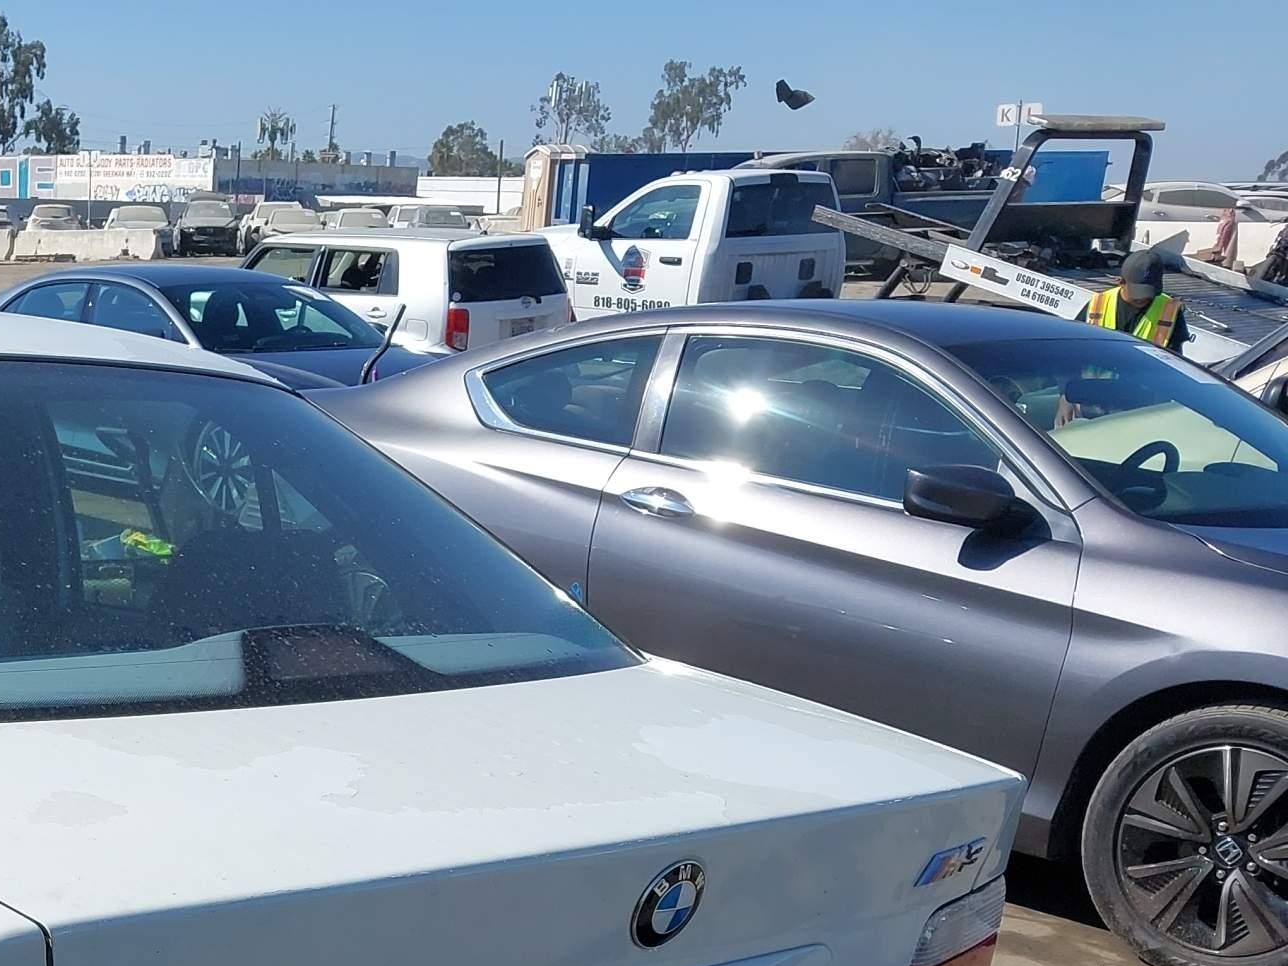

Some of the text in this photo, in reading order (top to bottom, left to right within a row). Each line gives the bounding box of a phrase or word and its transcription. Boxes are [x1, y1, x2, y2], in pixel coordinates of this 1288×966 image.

[1000, 108, 1012, 123] K
[1015, 272, 1075, 300] USDOT 3955492
[1020, 287, 1031, 298] CA
[652, 864, 705, 898] BMW
